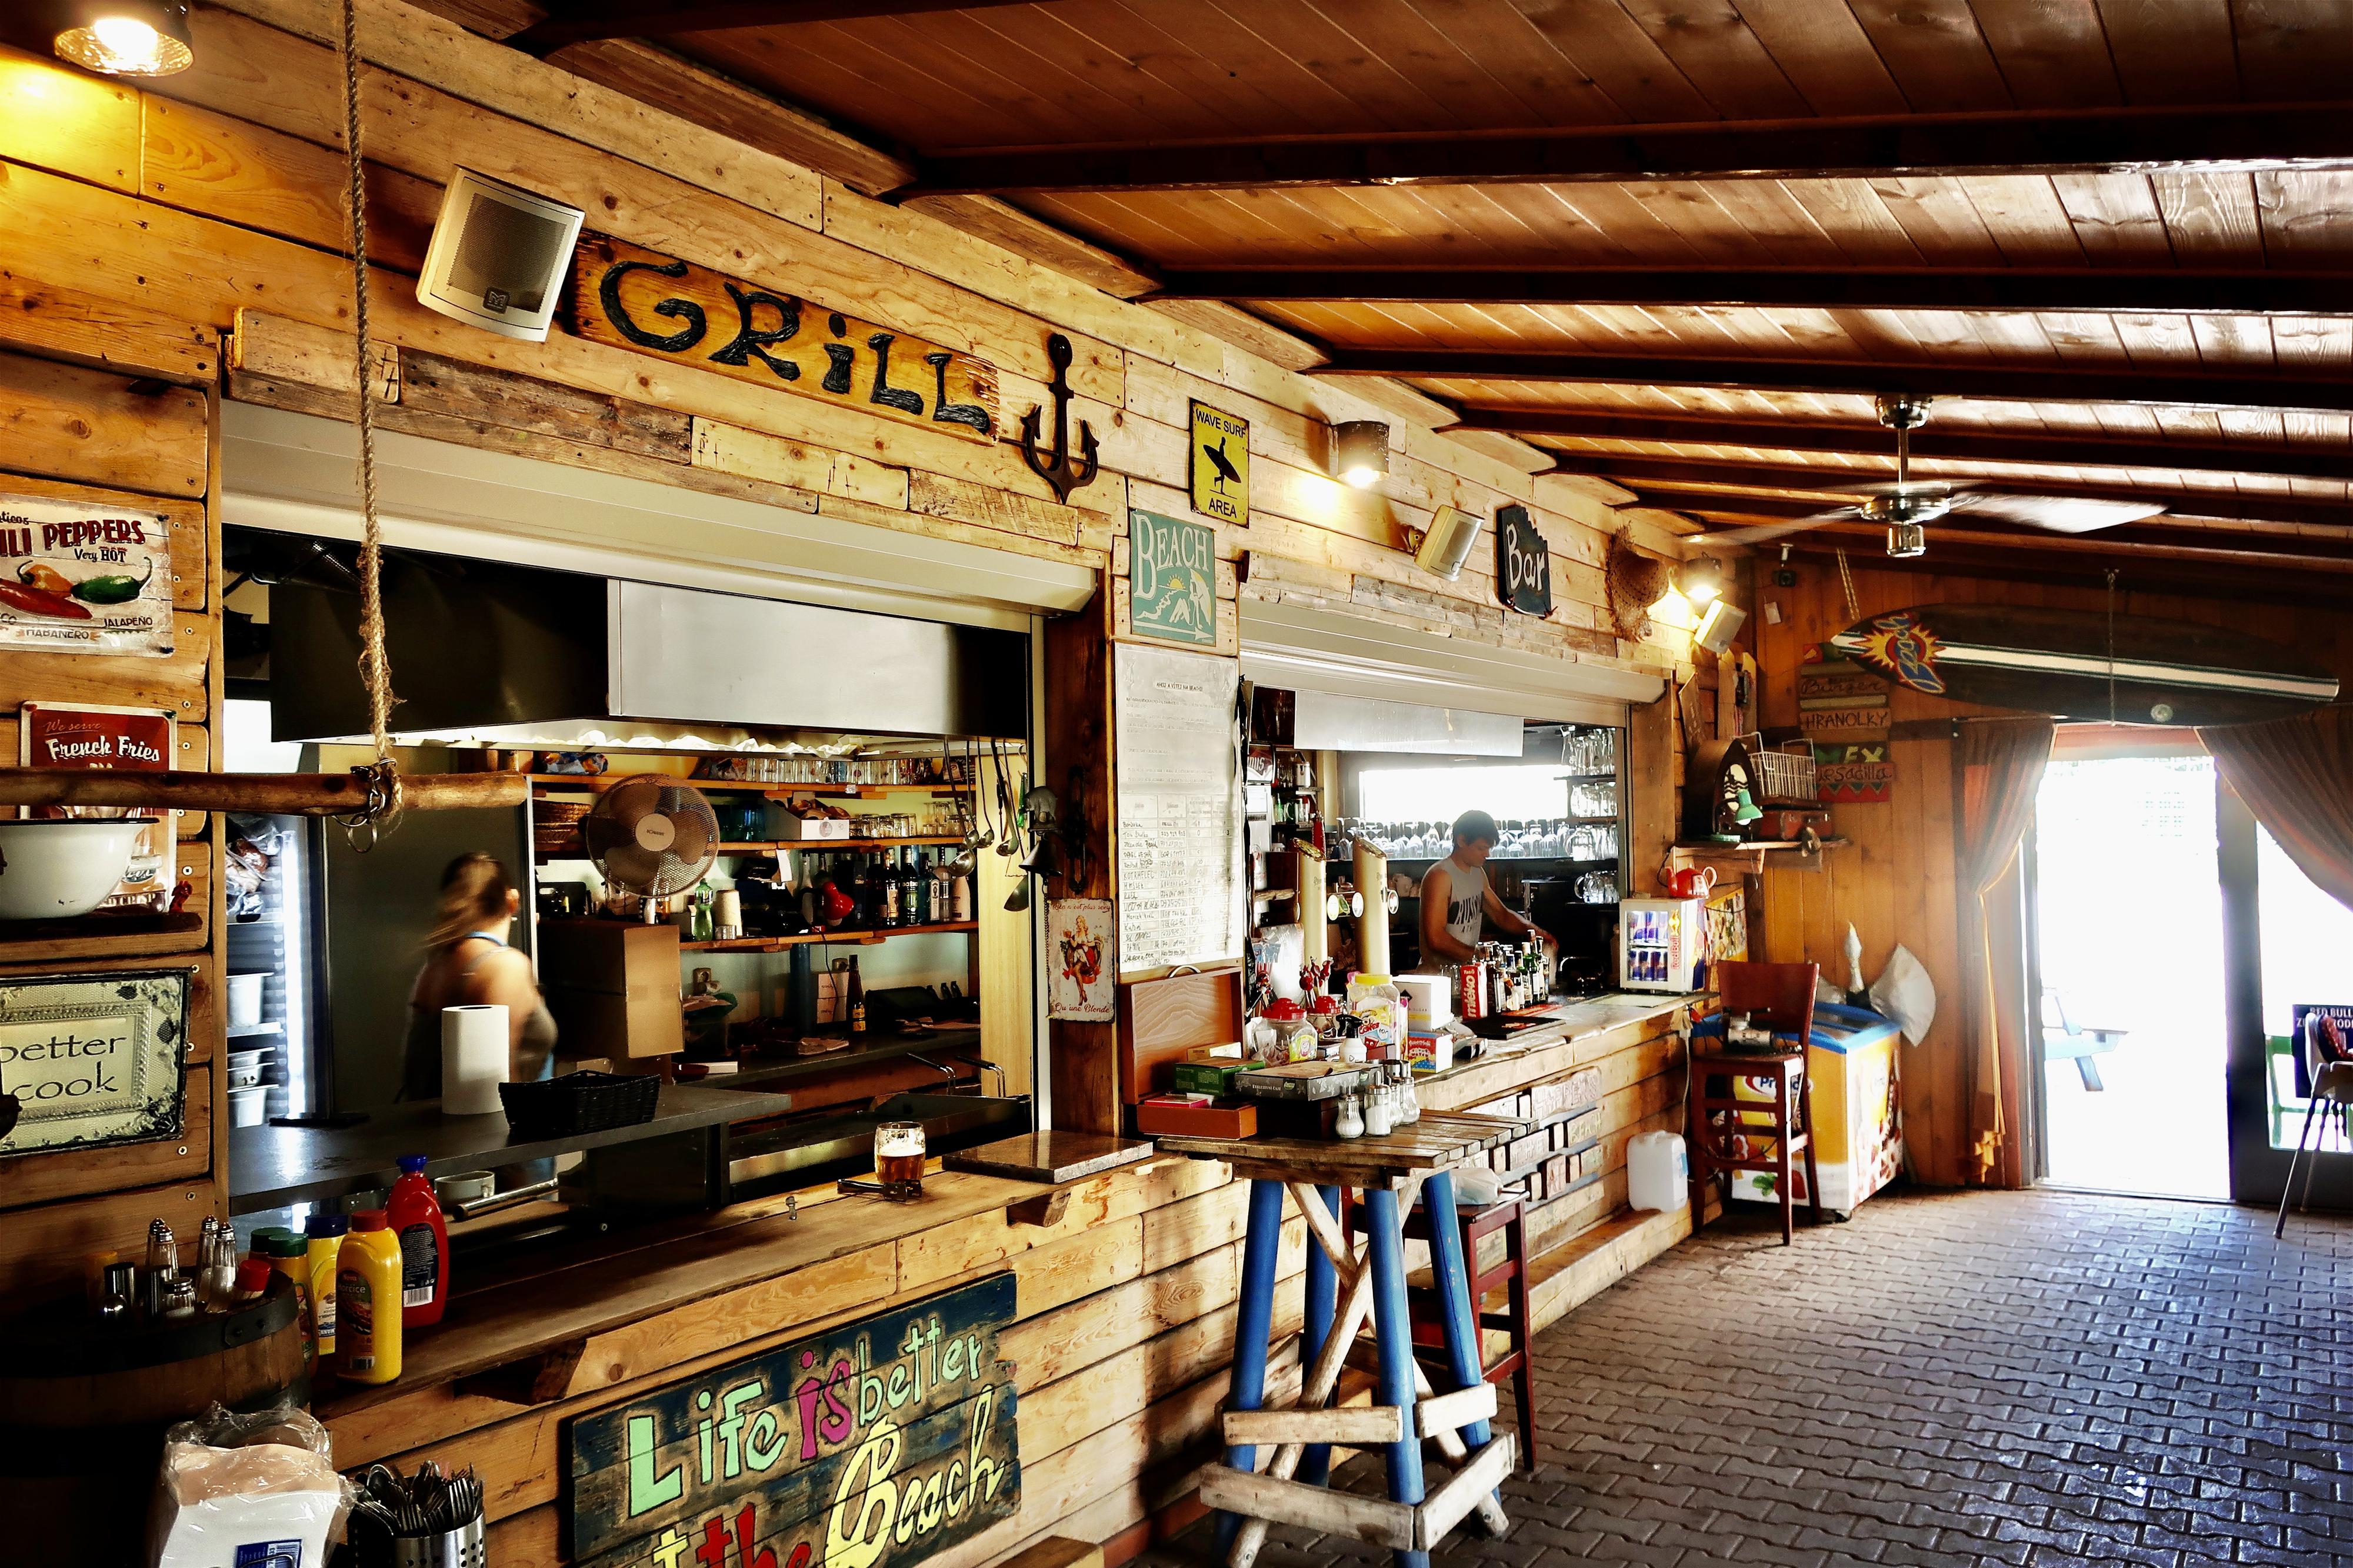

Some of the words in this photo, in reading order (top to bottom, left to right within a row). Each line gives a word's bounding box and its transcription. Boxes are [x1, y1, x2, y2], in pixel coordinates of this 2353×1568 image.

[1195, 408, 1222, 431] WAVE
[1222, 418, 1247, 439] SURF
[1208, 497, 1237, 519] AREA
[0, 528, 32, 557] ILI
[42, 519, 146, 551] PEPPERS
[74, 548, 97, 562] Very
[100, 548, 126, 563] HOT
[1133, 512, 1209, 600] BEACH
[1506, 523, 1545, 591] Bar
[104, 616, 153, 628] JALAPEÑO
[26, 629, 89, 639] HABANERO
[44, 719, 65, 733] We
[1805, 711, 1888, 730] HRANOLKY
[45, 735, 112, 761] French
[118, 735, 160, 762] Fries
[1670, 936, 1680, 952] Bull
[1671, 953, 1680, 969] Red
[1462, 975, 1477, 1018] mléko
[1084, 1003, 1110, 1014] Blonde
[2330, 1007, 2353, 1018] BULL
[10, 1060, 119, 1102] cook
[626, 1379, 788, 1519] Life
[796, 1349, 852, 1462] is
[858, 1316, 984, 1426] better
[824, 1384, 1005, 1568] Beach
